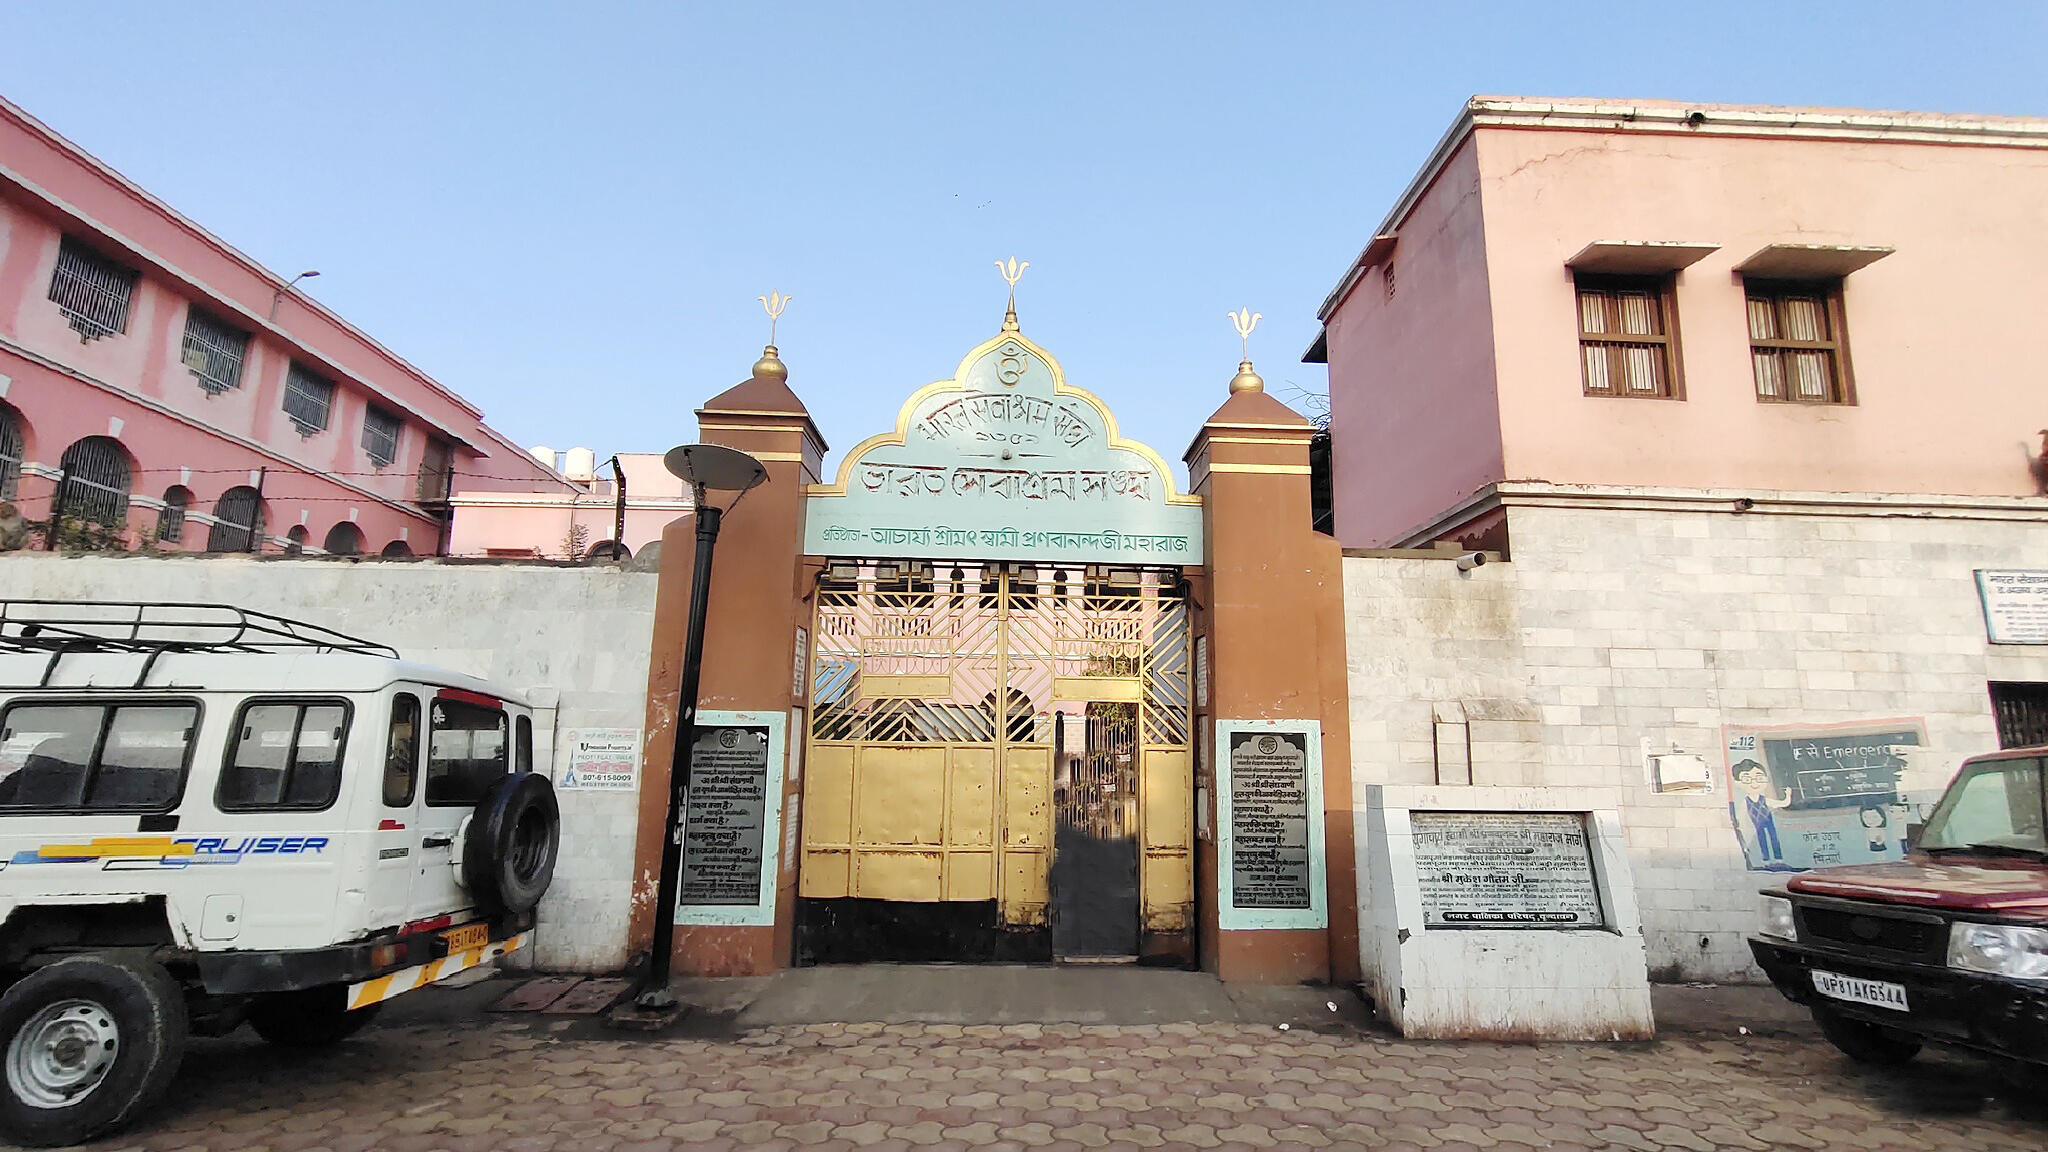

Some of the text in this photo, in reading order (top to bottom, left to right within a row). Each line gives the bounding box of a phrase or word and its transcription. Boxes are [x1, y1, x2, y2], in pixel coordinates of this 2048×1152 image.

[859, 462, 947, 497] ভারত
[980, 526, 1019, 549] স্বামী
[1124, 535, 1188, 554] মহারাজ
[1441, 872, 1454, 883] श्री
[1455, 873, 1481, 885] मुकेश
[1483, 872, 1510, 883] गौतम
[1511, 872, 1524, 883] जी
[1472, 912, 1503, 920] पालिका
[1822, 977, 1904, 1004] UP81AK6544
